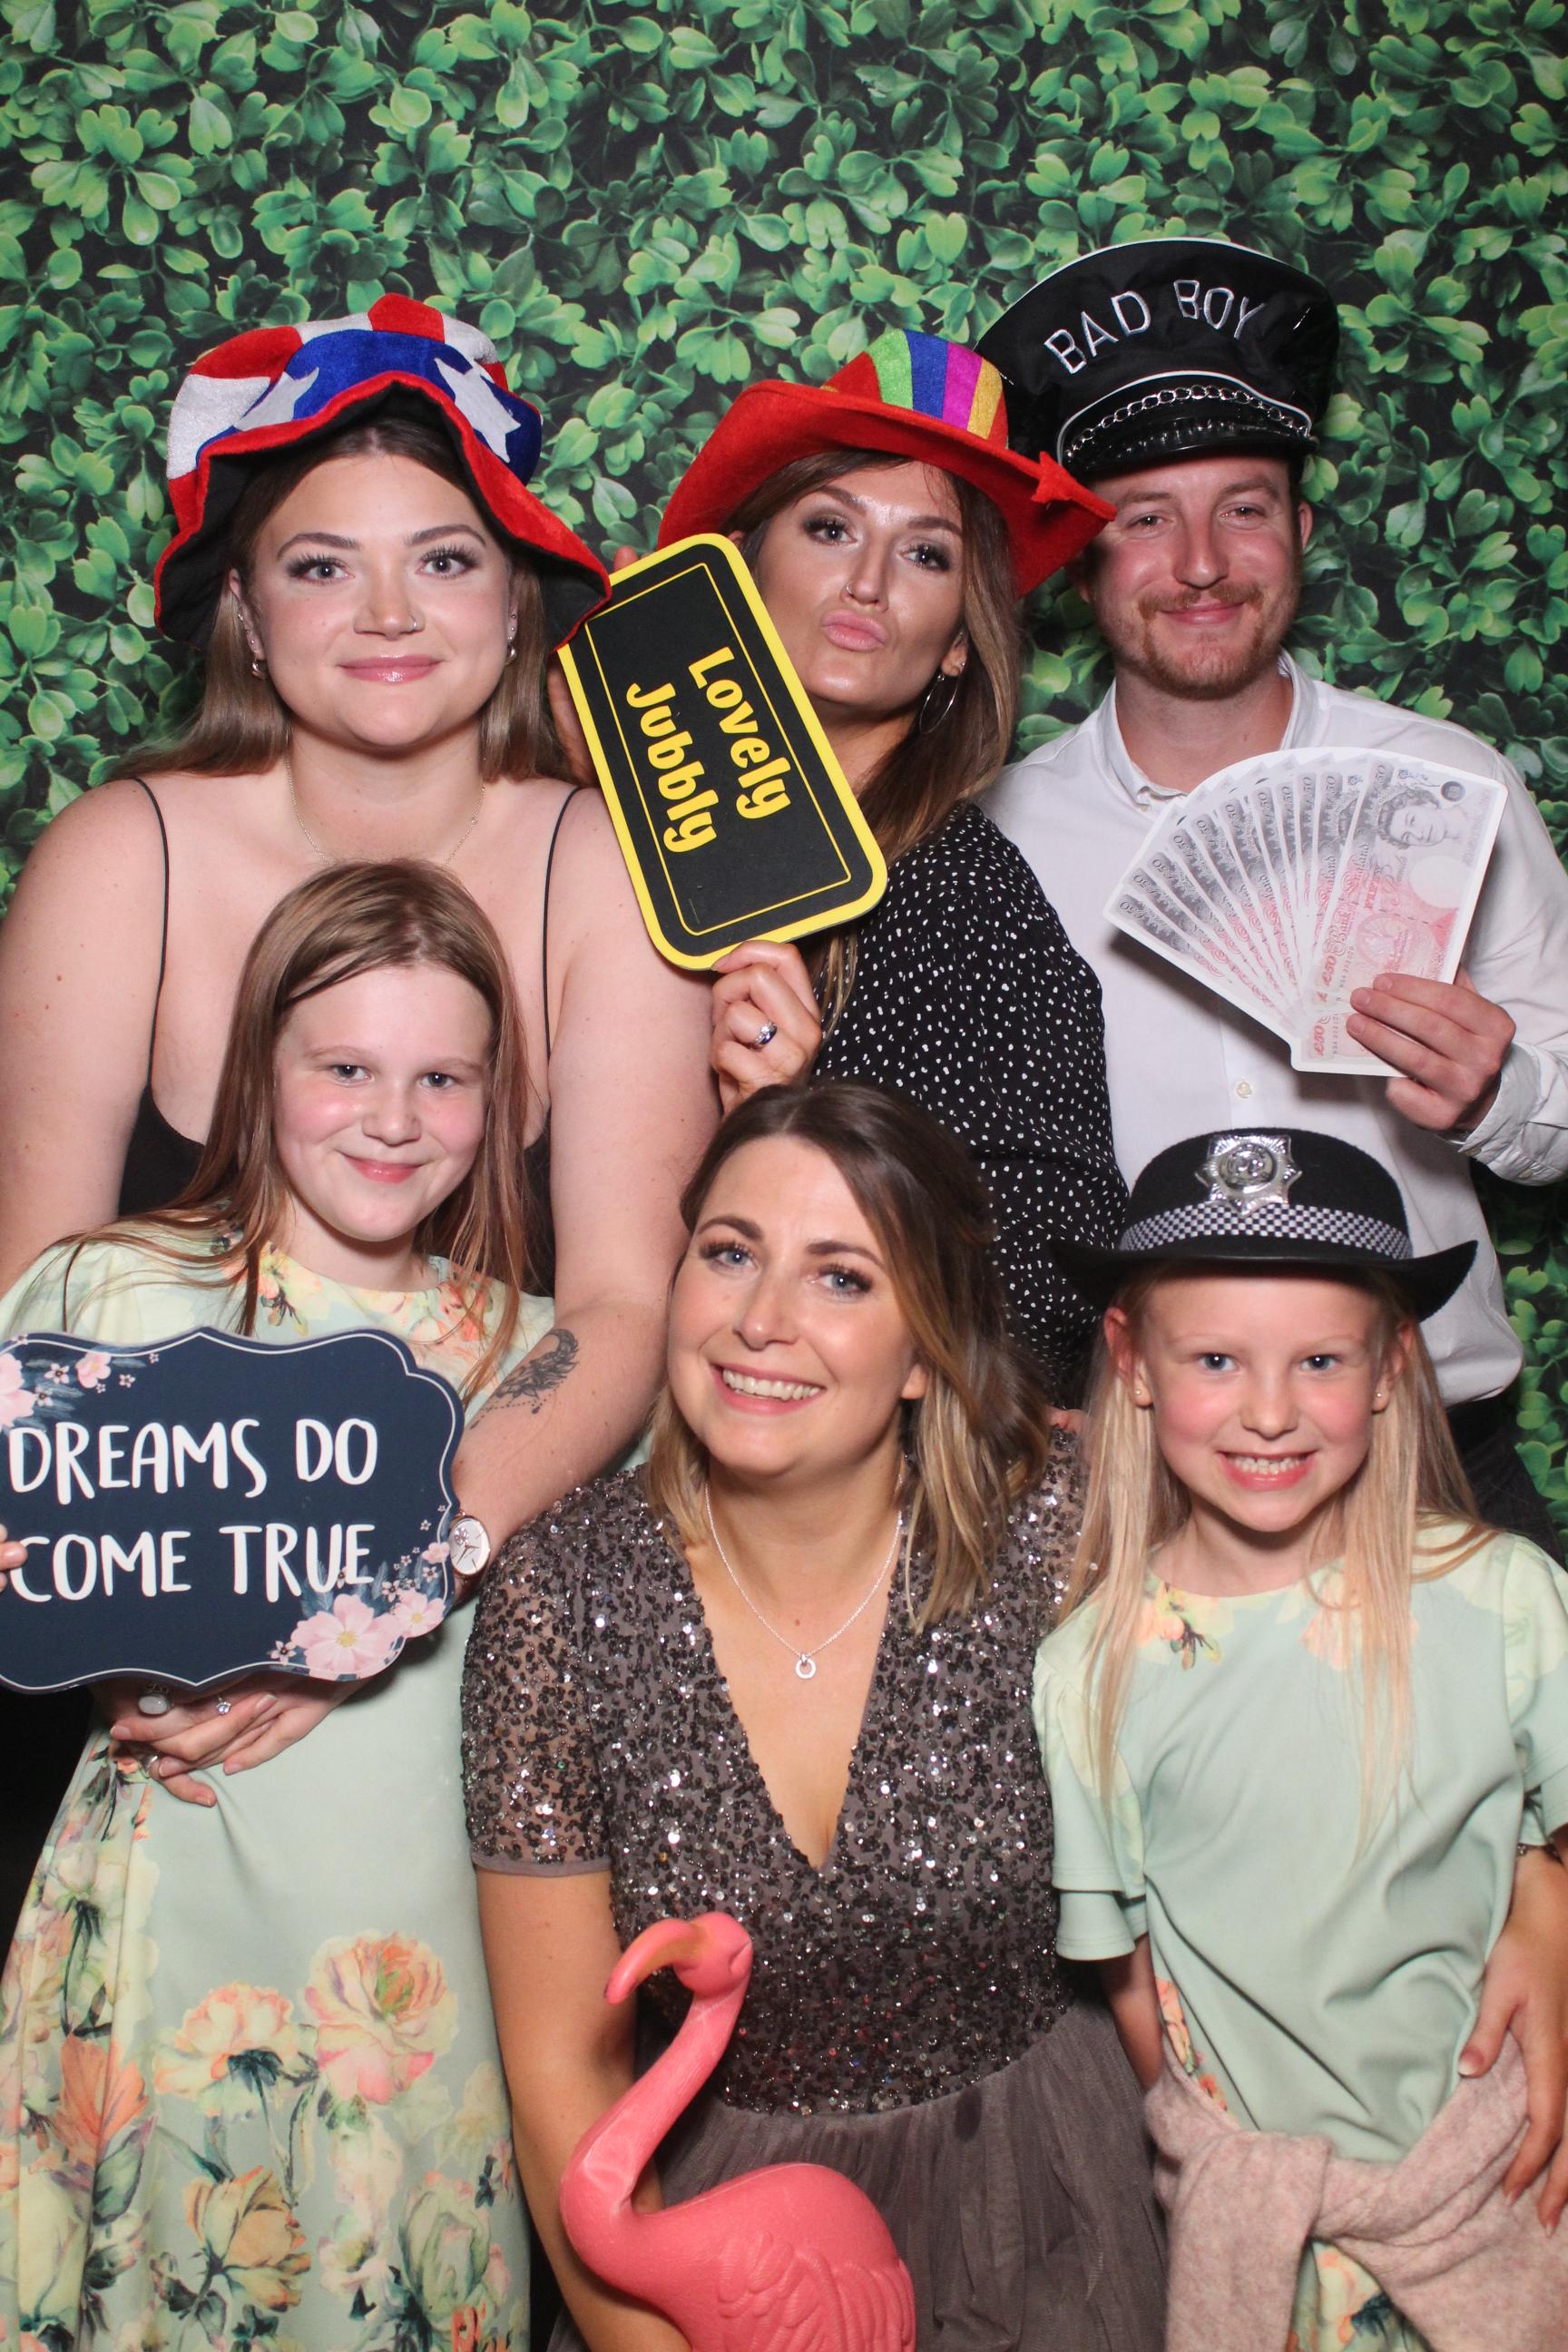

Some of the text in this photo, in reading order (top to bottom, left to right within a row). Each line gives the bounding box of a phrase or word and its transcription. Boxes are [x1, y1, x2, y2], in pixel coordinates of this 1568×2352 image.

[1044, 279, 1266, 374] BAD BOY
[626, 682, 720, 854] Jubbly
[688, 646, 792, 819] Lovely
[1322, 907, 1351, 956] Bank
[1322, 956, 1336, 987] £50
[1314, 1025, 1325, 1056] £50
[8, 1417, 378, 1505] DREAMS DO
[9, 1523, 376, 1603] COME TRUE
